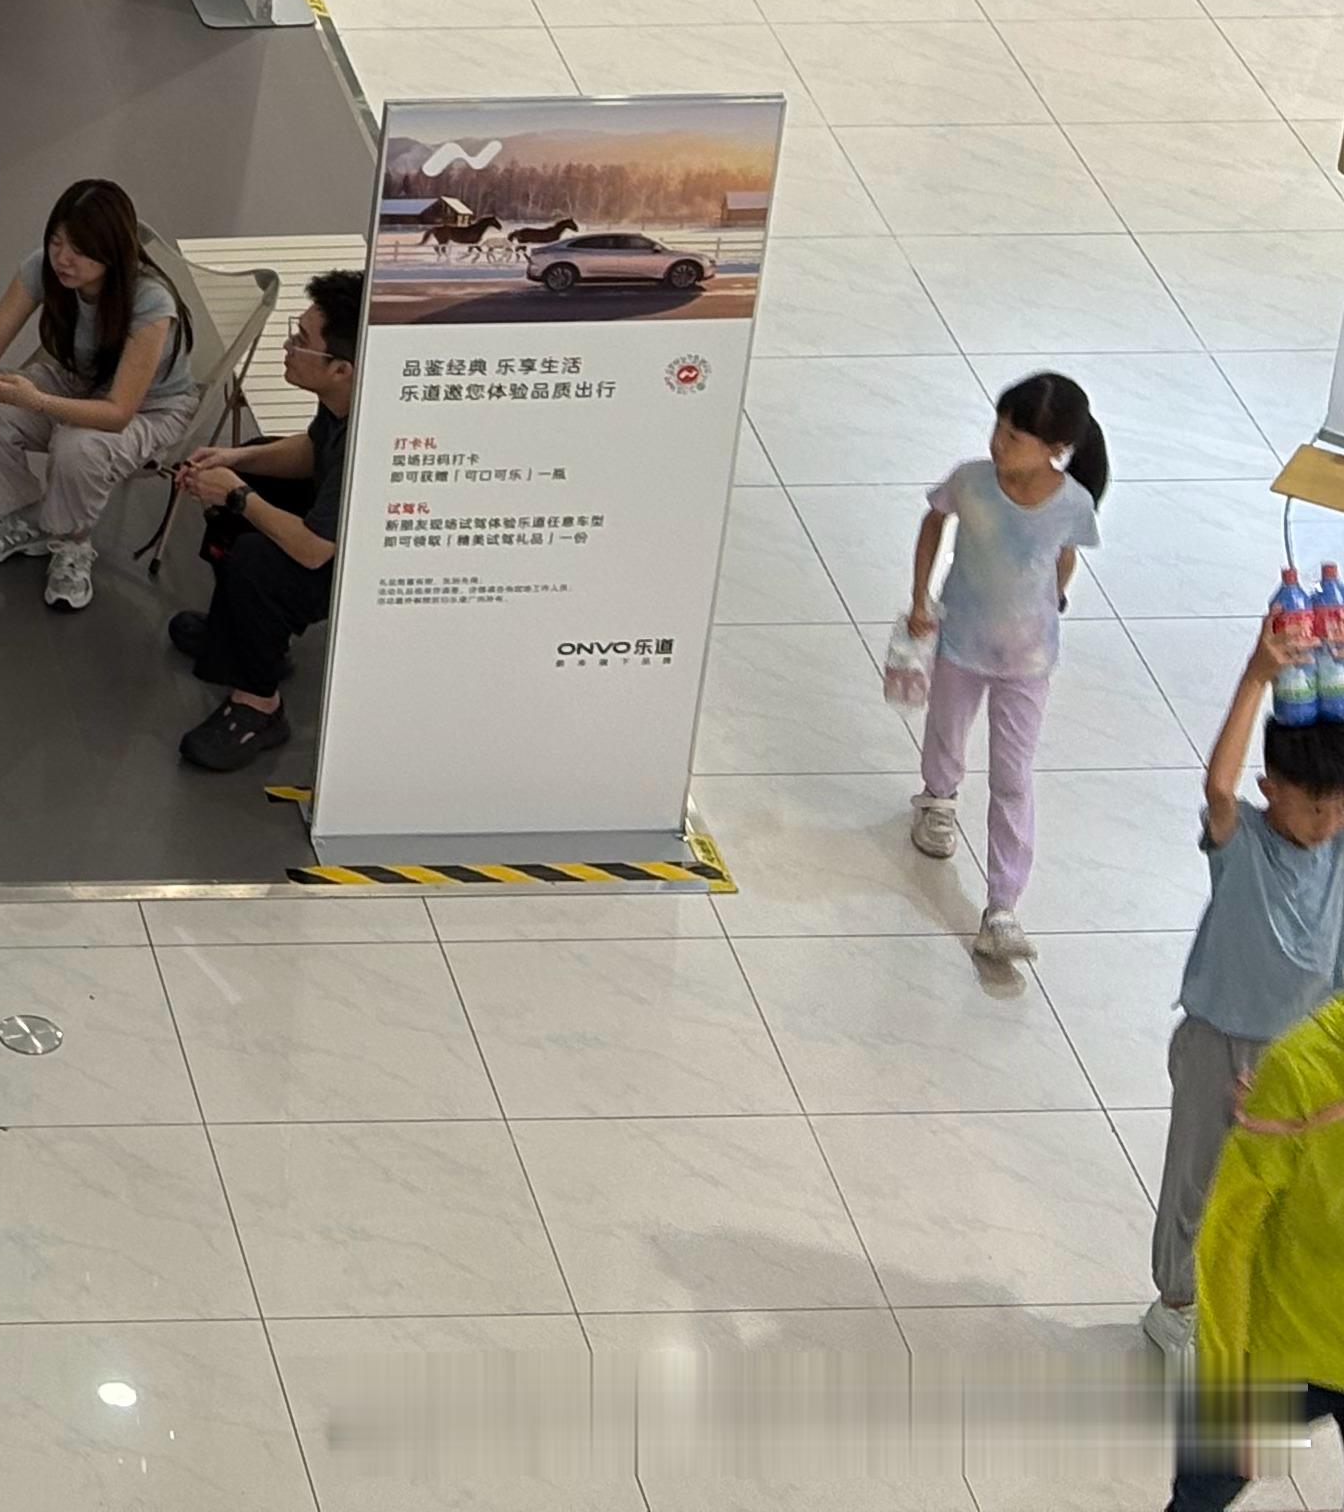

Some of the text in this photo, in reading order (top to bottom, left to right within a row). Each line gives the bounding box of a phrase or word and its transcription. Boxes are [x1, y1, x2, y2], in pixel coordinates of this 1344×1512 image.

[402, 356, 582, 377] 品鉴经典 乐享生活
[399, 380, 616, 402] 乐道邀您体验品质出行
[393, 437, 438, 450] 打卡礼
[392, 454, 480, 466] 现场扫码打卡
[557, 638, 674, 656] ONVO 乐道
